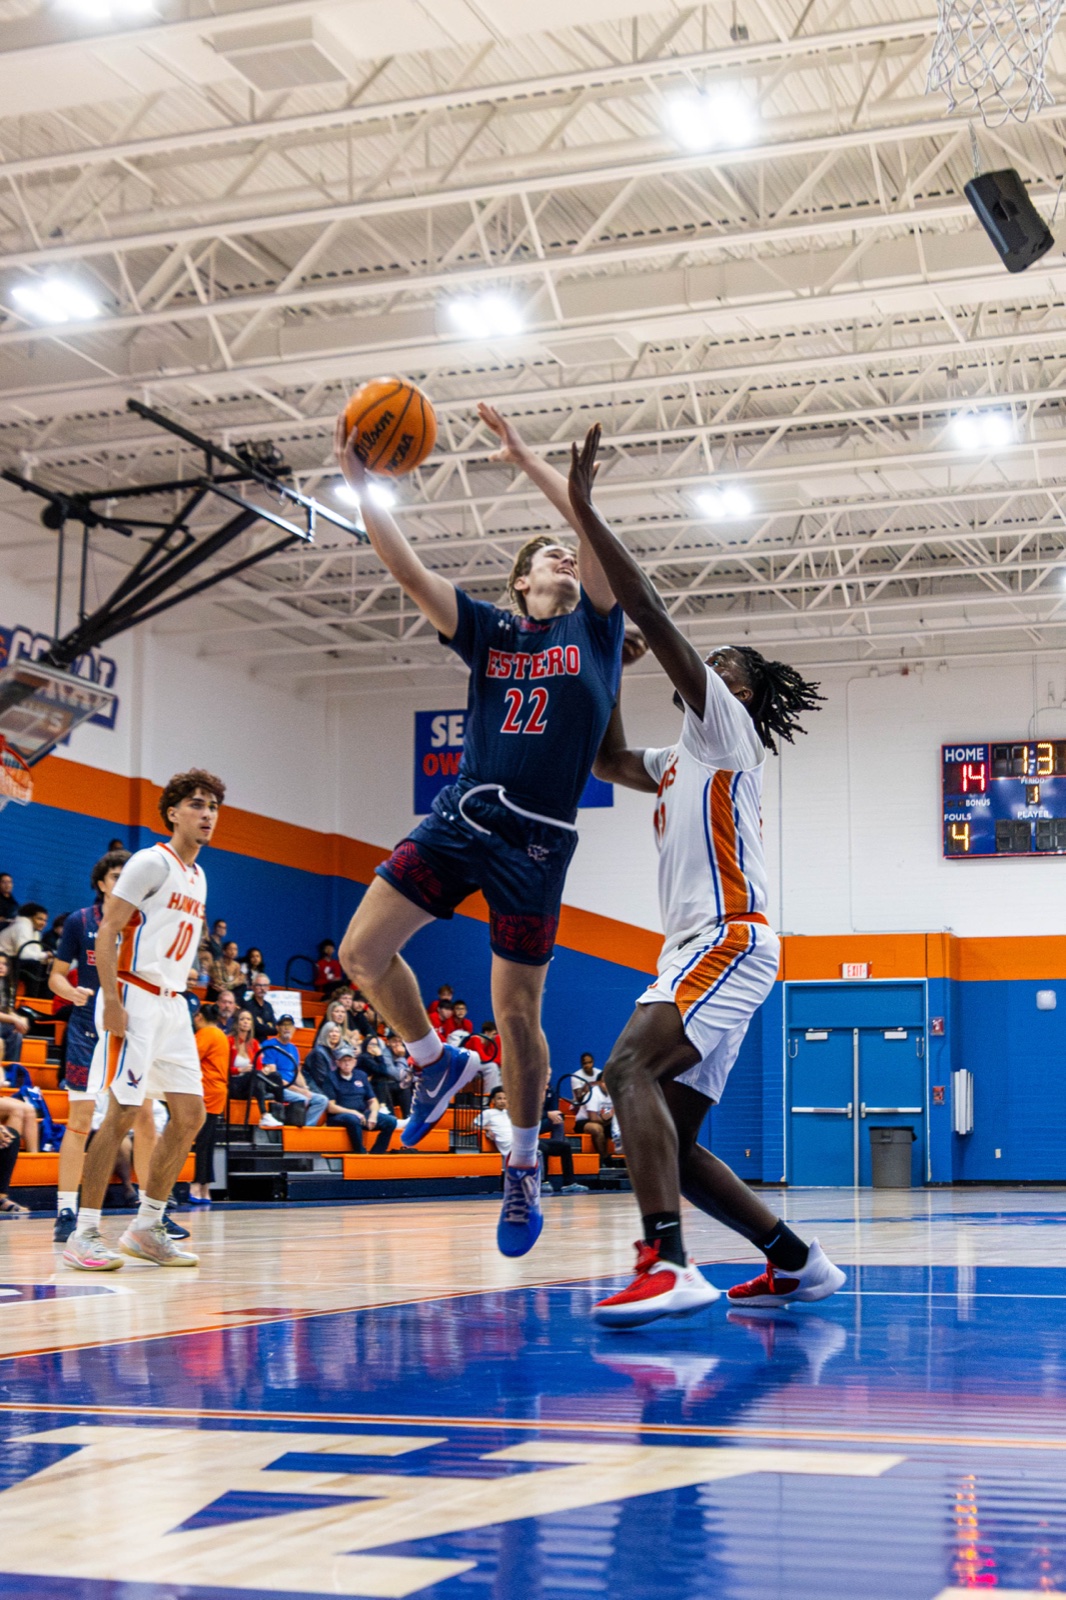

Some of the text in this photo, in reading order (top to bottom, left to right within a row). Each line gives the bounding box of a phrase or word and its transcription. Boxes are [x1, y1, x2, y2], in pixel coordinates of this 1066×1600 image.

[485, 644, 581, 680] ESTERO
[500, 687, 549, 735] 22
[945, 747, 984, 762] HOME
[962, 763, 985, 792] 14
[944, 812, 972, 822] FOULS
[965, 798, 991, 807] BONUS
[951, 823, 969, 852] 4
[167, 891, 207, 920] HAWKS
[165, 920, 195, 962] 10
[847, 965, 863, 977] EXIT
